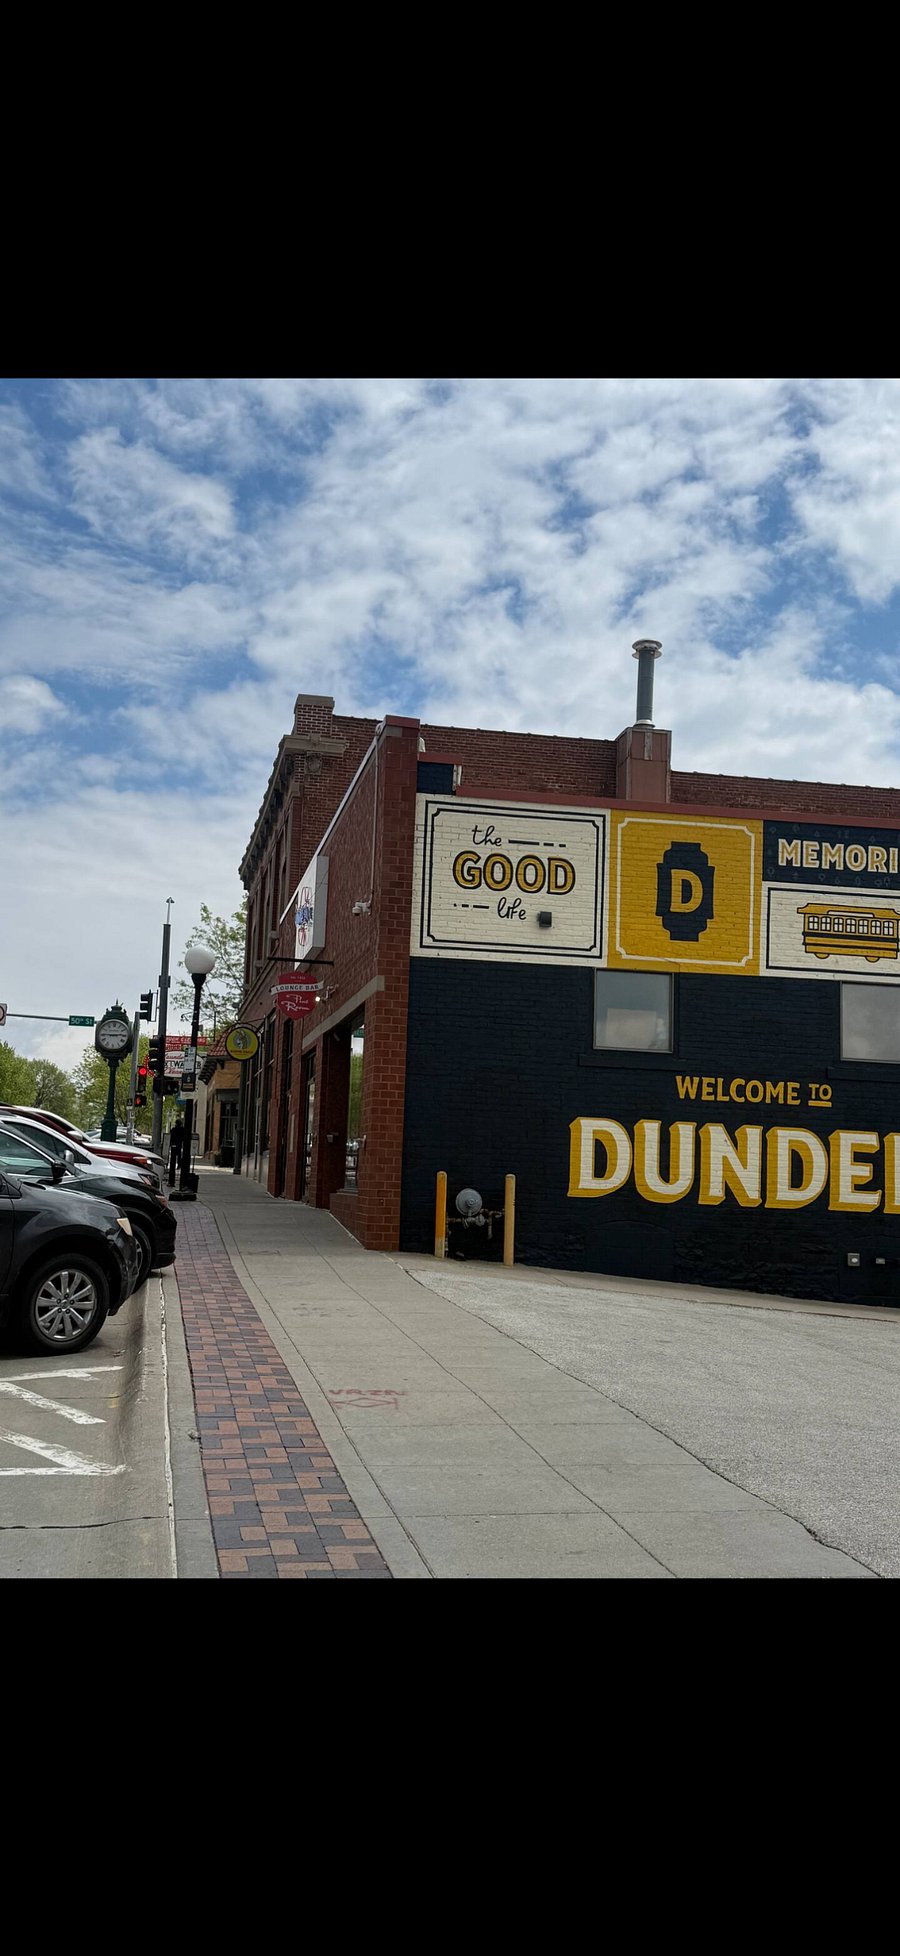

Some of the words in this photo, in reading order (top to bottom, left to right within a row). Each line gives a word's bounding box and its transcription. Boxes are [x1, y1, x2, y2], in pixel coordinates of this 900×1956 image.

[471, 824, 502, 847] the
[452, 850, 576, 895] GOOD
[778, 838, 898, 874] MEMORI
[670, 868, 703, 912] D
[497, 896, 527, 920] life
[275, 984, 304, 992] LOUNGE
[675, 1075, 801, 1106] WELCOME
[808, 1083, 833, 1103] TO
[567, 1116, 900, 1215] DUNDE
